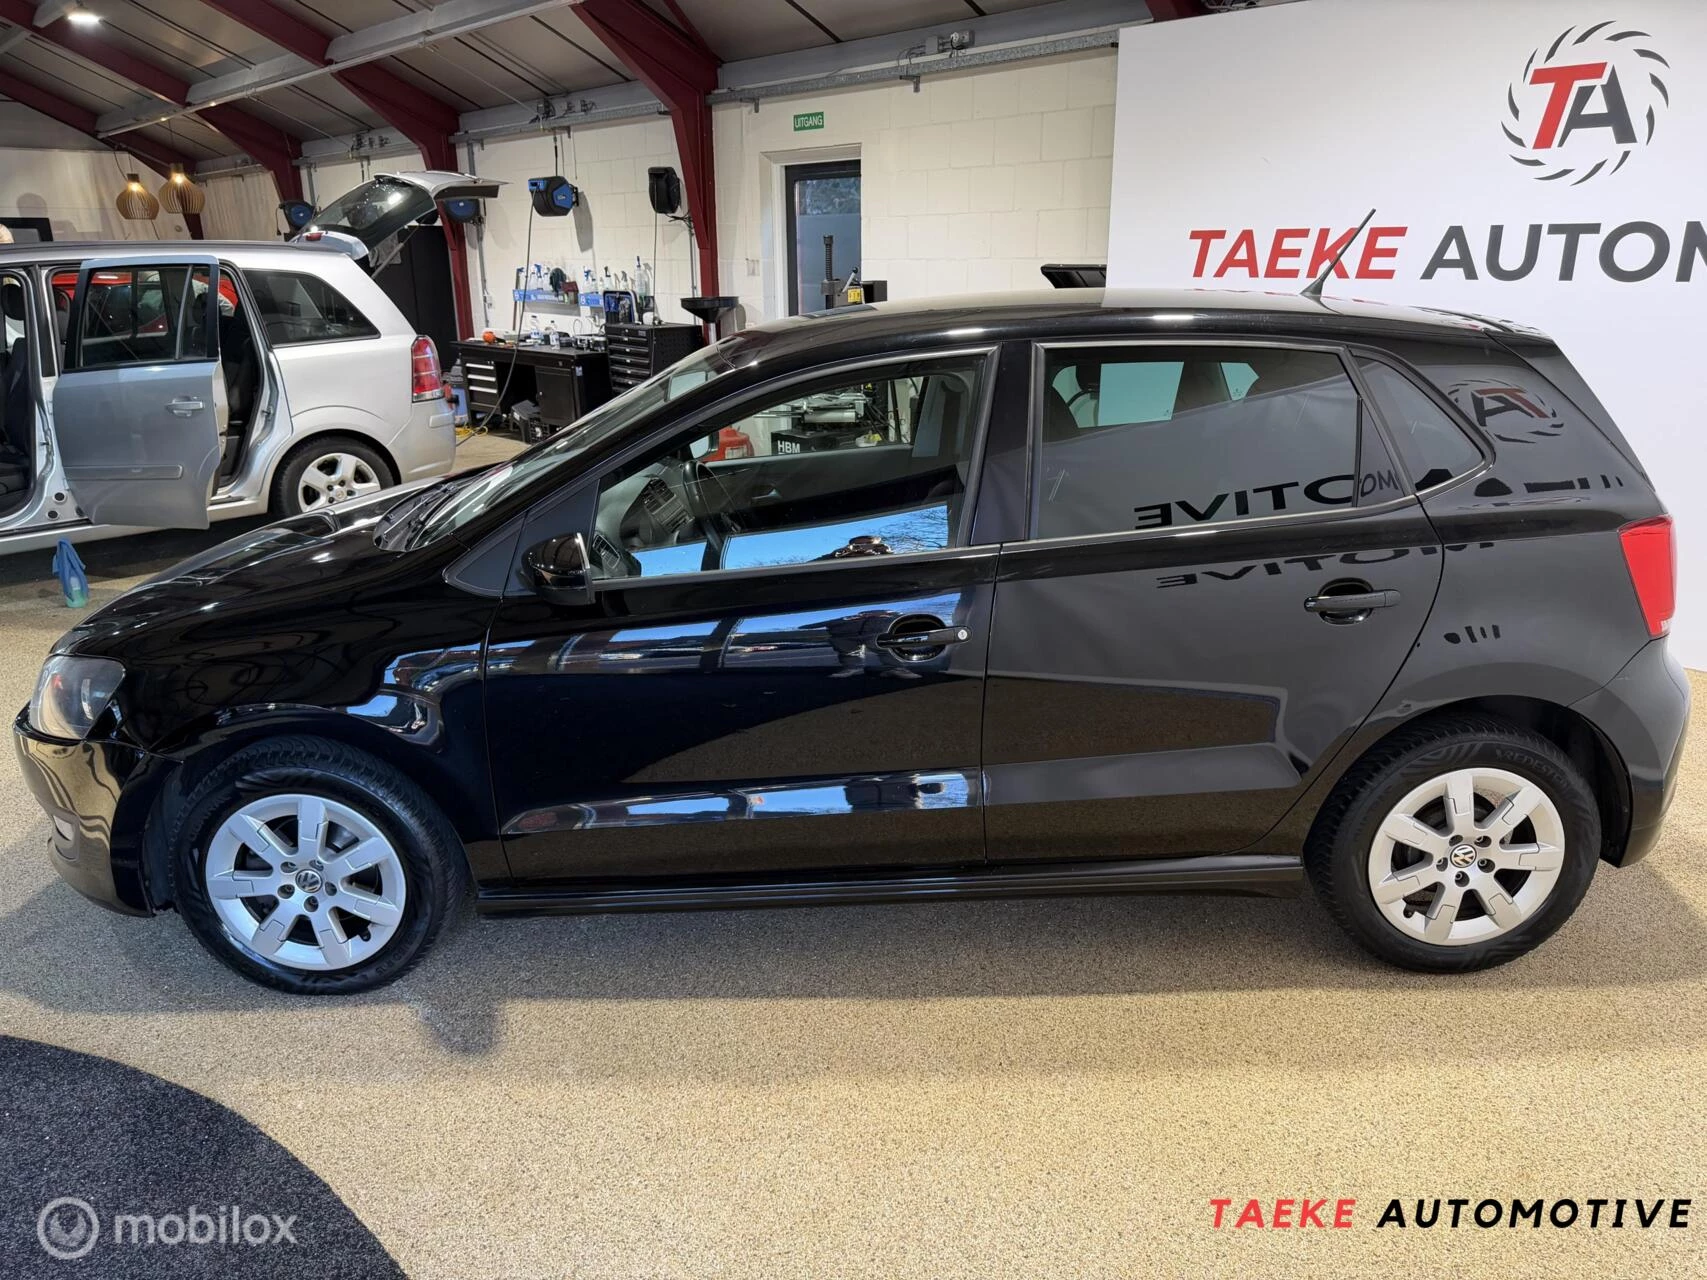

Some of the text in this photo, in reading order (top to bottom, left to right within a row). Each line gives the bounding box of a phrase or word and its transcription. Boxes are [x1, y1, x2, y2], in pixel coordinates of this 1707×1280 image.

[794, 115, 823, 128] UITGANG
[1530, 62, 1638, 150] TA
[1189, 226, 1408, 280] TAEKE
[777, 439, 801, 454] HBM
